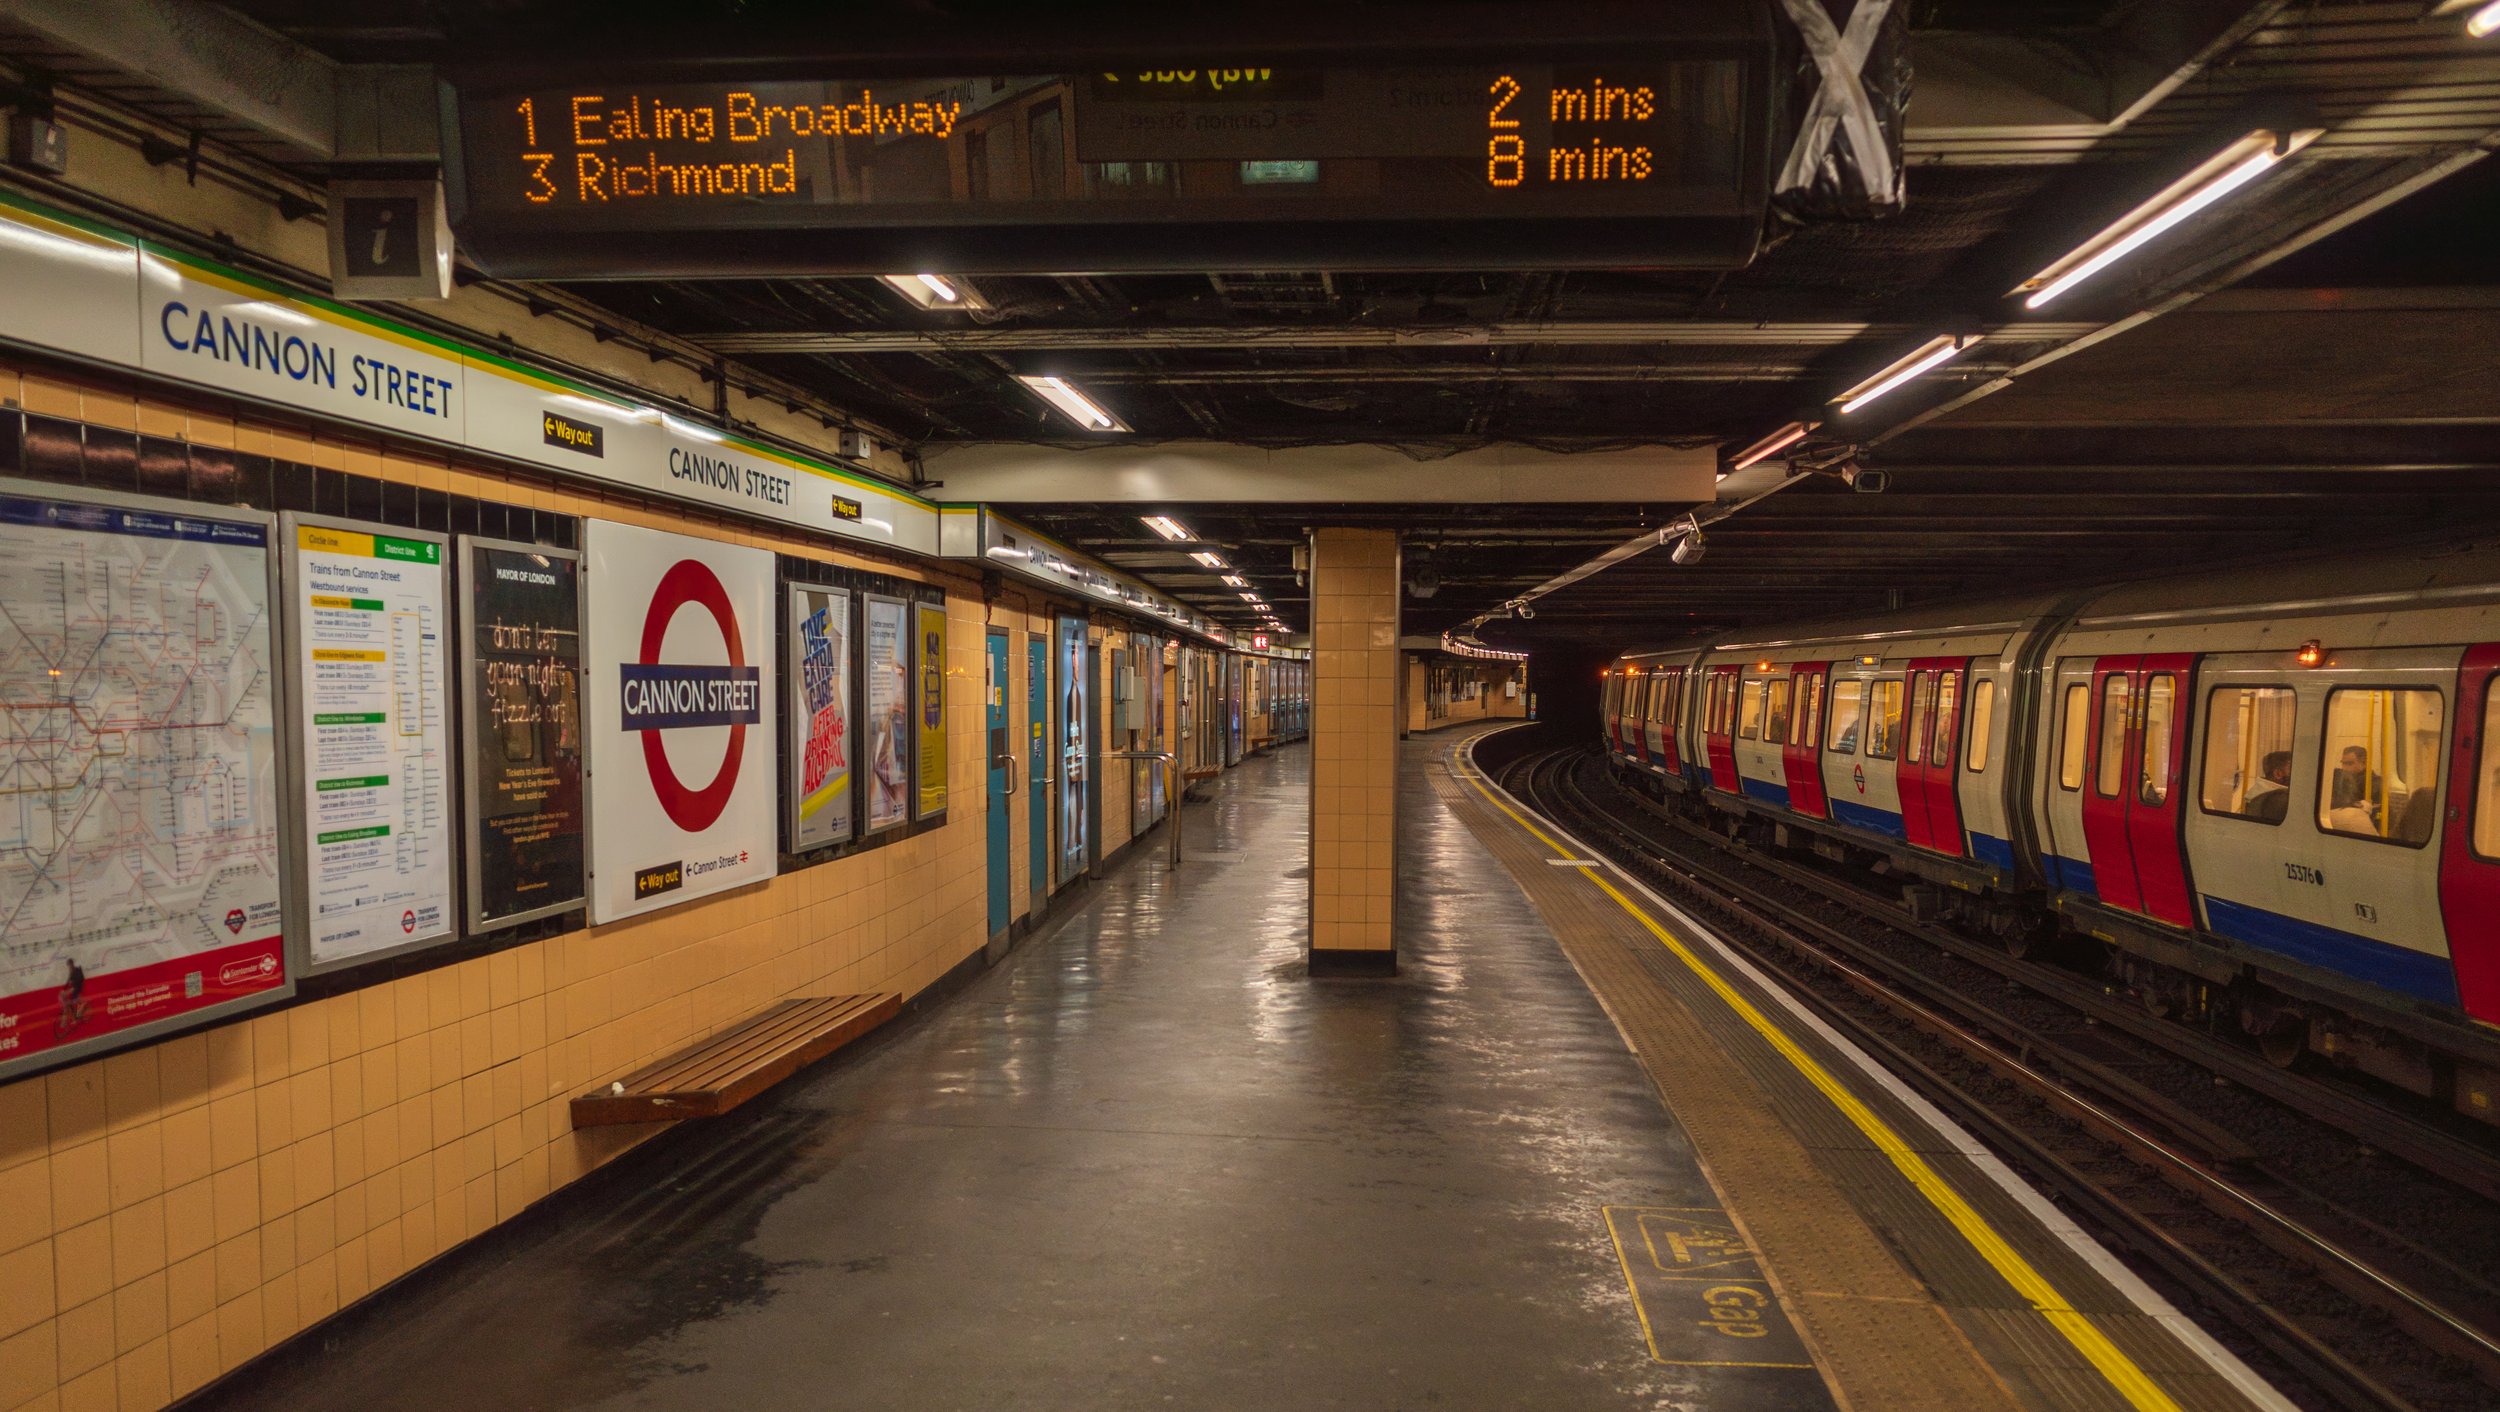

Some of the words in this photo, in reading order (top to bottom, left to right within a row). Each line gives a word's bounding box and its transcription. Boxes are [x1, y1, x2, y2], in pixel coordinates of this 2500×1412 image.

[518, 98, 536, 146] 1
[572, 95, 715, 144] Ealing
[727, 89, 961, 143] Broadway
[1489, 76, 1520, 128] 2
[1552, 78, 1654, 121] mins
[523, 153, 557, 202] 3
[577, 149, 796, 200] Richmond
[1488, 135, 1525, 187] 8
[1550, 138, 1652, 181] mins
[160, 301, 335, 389] CANNON
[352, 354, 453, 418] STREET
[555, 419, 576, 445] Way
[577, 430, 593, 446] out
[669, 448, 740, 493] CANNON
[745, 469, 791, 506] STREET
[837, 500, 849, 516] Way
[849, 505, 857, 516] out
[309, 535, 326, 545] Circle
[326, 537, 338, 546] line
[384, 543, 405, 555] District
[405, 546, 417, 556] line
[310, 562, 331, 575] Trains
[333, 564, 350, 576] from
[352, 566, 378, 579] Cannon
[380, 569, 400, 581] Street
[310, 581, 344, 592] Westbound
[346, 585, 368, 593] services
[497, 568, 519, 580] MAYOR
[519, 571, 528, 582] OF
[529, 573, 556, 585] LONDON
[494, 616, 530, 649] don't
[536, 621, 557, 651] let
[801, 607, 831, 658] TAKE
[487, 661, 523, 697] your
[528, 655, 566, 697] night
[803, 642, 834, 690] EXTRA
[491, 695, 542, 729] fizzle
[624, 680, 704, 715] CANNON
[707, 680, 758, 712] STREET
[810, 676, 834, 714] CARE
[813, 704, 836, 740] AFTER
[805, 717, 843, 762] DRINKING
[506, 768, 525, 777] Tickets
[525, 767, 532, 775] to
[532, 766, 555, 775] London's
[528, 780, 537, 788] Eve
[803, 742, 845, 797] ALCOHOL
[647, 871, 664, 889] Way
[665, 867, 679, 884] out
[693, 860, 718, 876] Cannon
[718, 854, 738, 869] Street
[2285, 862, 2315, 885] 25376
[231, 964, 258, 977] Santander
[1697, 1286, 1769, 1338] Gap
